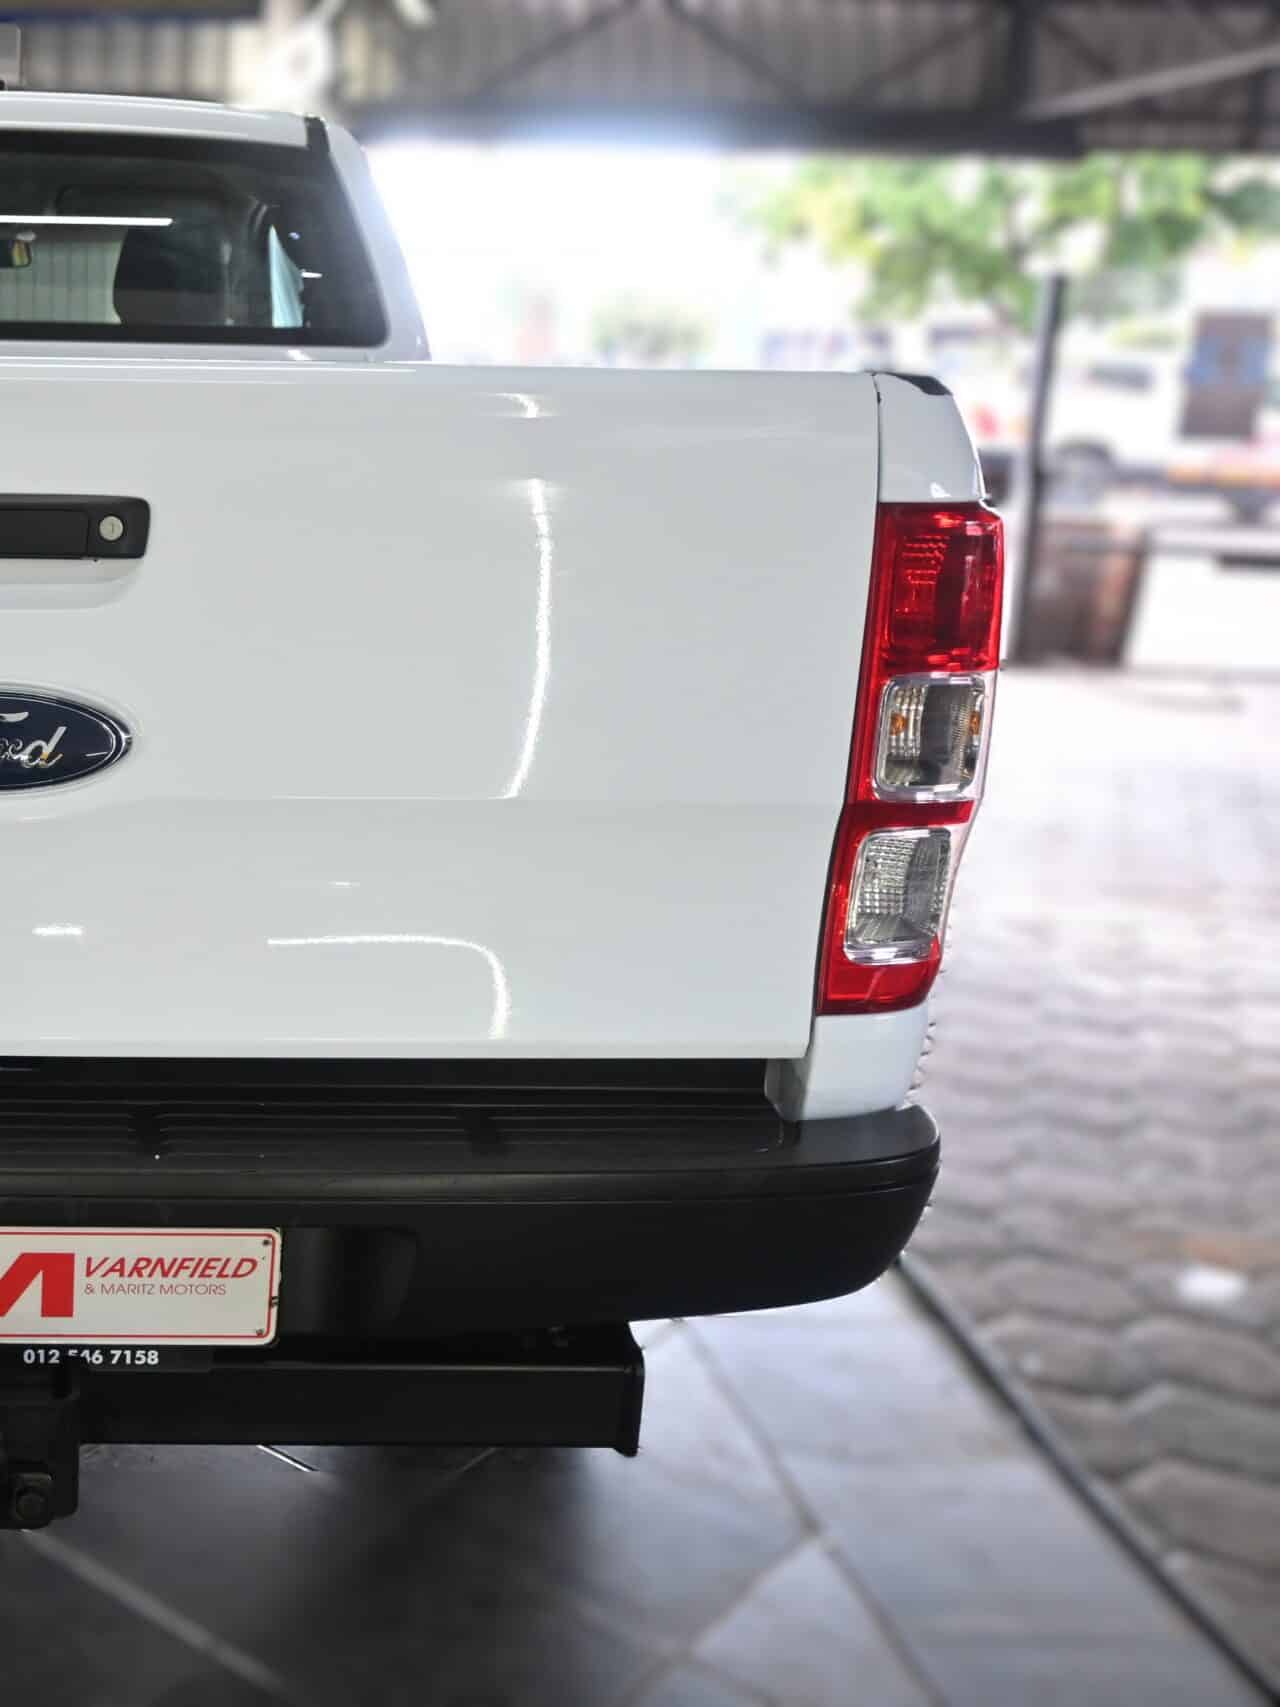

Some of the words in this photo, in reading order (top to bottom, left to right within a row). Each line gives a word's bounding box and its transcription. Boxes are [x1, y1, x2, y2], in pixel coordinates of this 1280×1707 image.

[84, 1256, 258, 1279] VARNFIELD
[84, 1283, 95, 1296] &
[101, 1283, 156, 1296] MARITZ
[160, 1283, 227, 1296] MOTORS
[23, 1349, 60, 1364] 012
[110, 1349, 159, 1365] 7158
